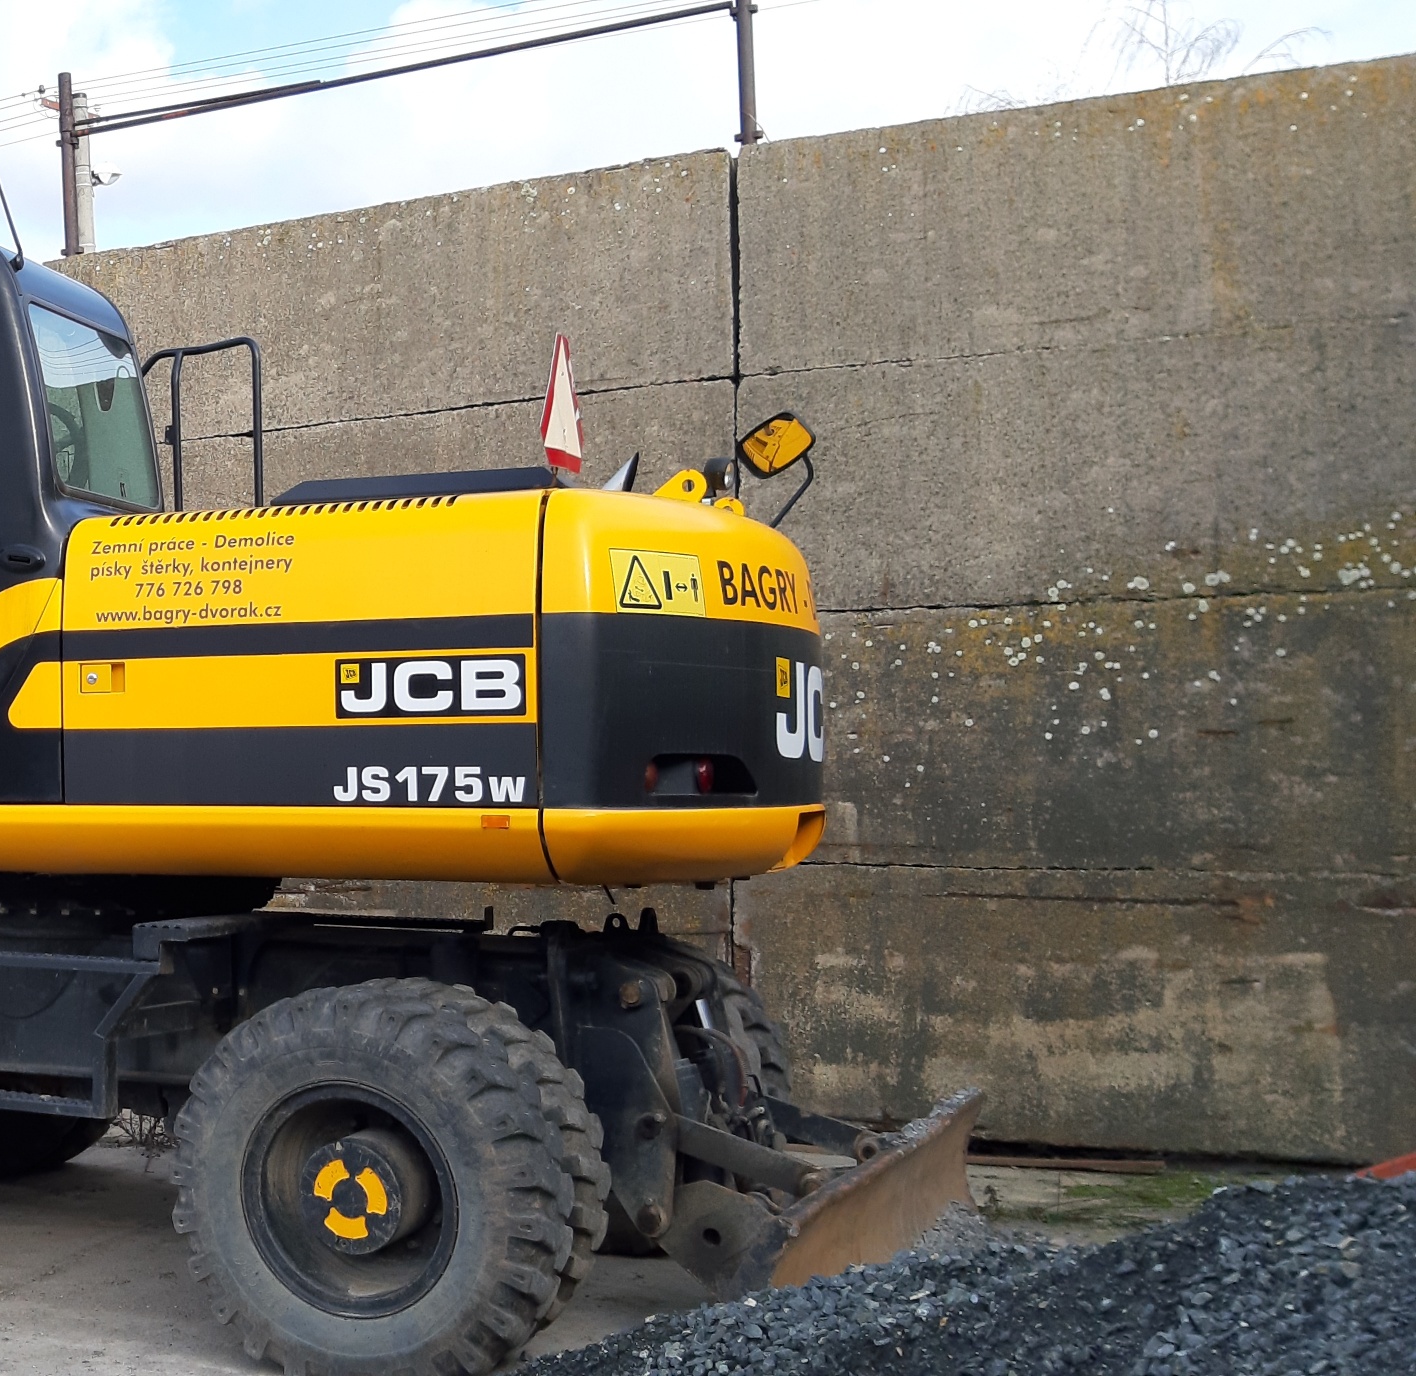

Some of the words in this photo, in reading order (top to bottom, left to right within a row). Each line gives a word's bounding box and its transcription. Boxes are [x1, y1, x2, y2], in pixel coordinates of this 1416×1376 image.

[91, 538, 145, 555] Zemní
[148, 537, 195, 556] práce
[214, 531, 295, 549] Demolice
[90, 560, 132, 581] písky
[140, 558, 194, 577] štěrky,
[200, 554, 293, 575] kontejnery
[135, 582, 165, 598] 776
[172, 580, 204, 597] 726
[210, 579, 242, 595] 798
[716, 560, 798, 614] BAGRY
[95, 601, 282, 625] www.bagry-dvorak.cz
[340, 659, 522, 713] JCB
[776, 661, 824, 763] JC
